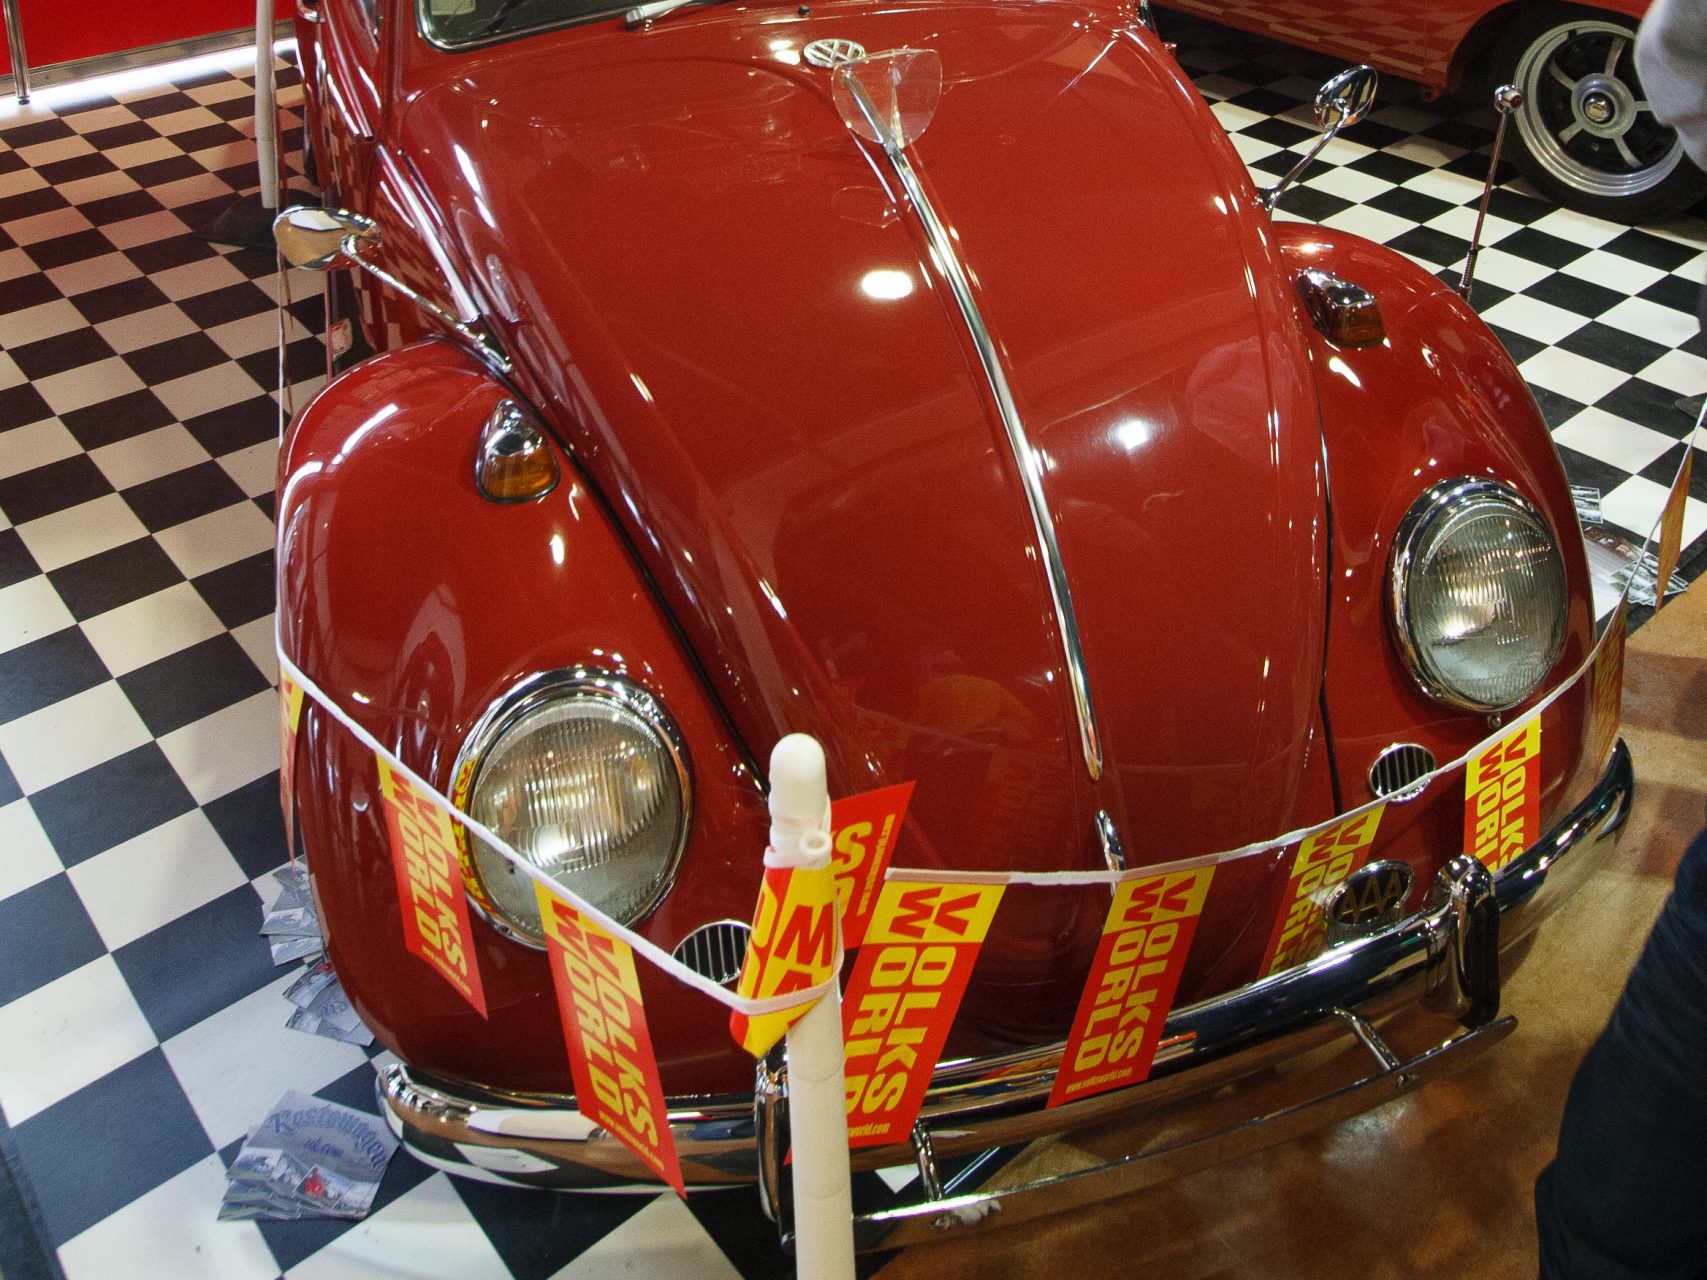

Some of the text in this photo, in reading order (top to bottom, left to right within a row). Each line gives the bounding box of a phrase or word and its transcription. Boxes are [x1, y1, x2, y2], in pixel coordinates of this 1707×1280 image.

[389, 766, 440, 953] WORLD
[415, 796, 468, 980] VOLKS
[552, 900, 623, 1117] WORLD
[585, 930, 659, 1149] VOLKS
[862, 891, 982, 1115] VOLKS
[1073, 876, 1166, 1072] WORLD
[1107, 874, 1198, 1062] VOLKS
